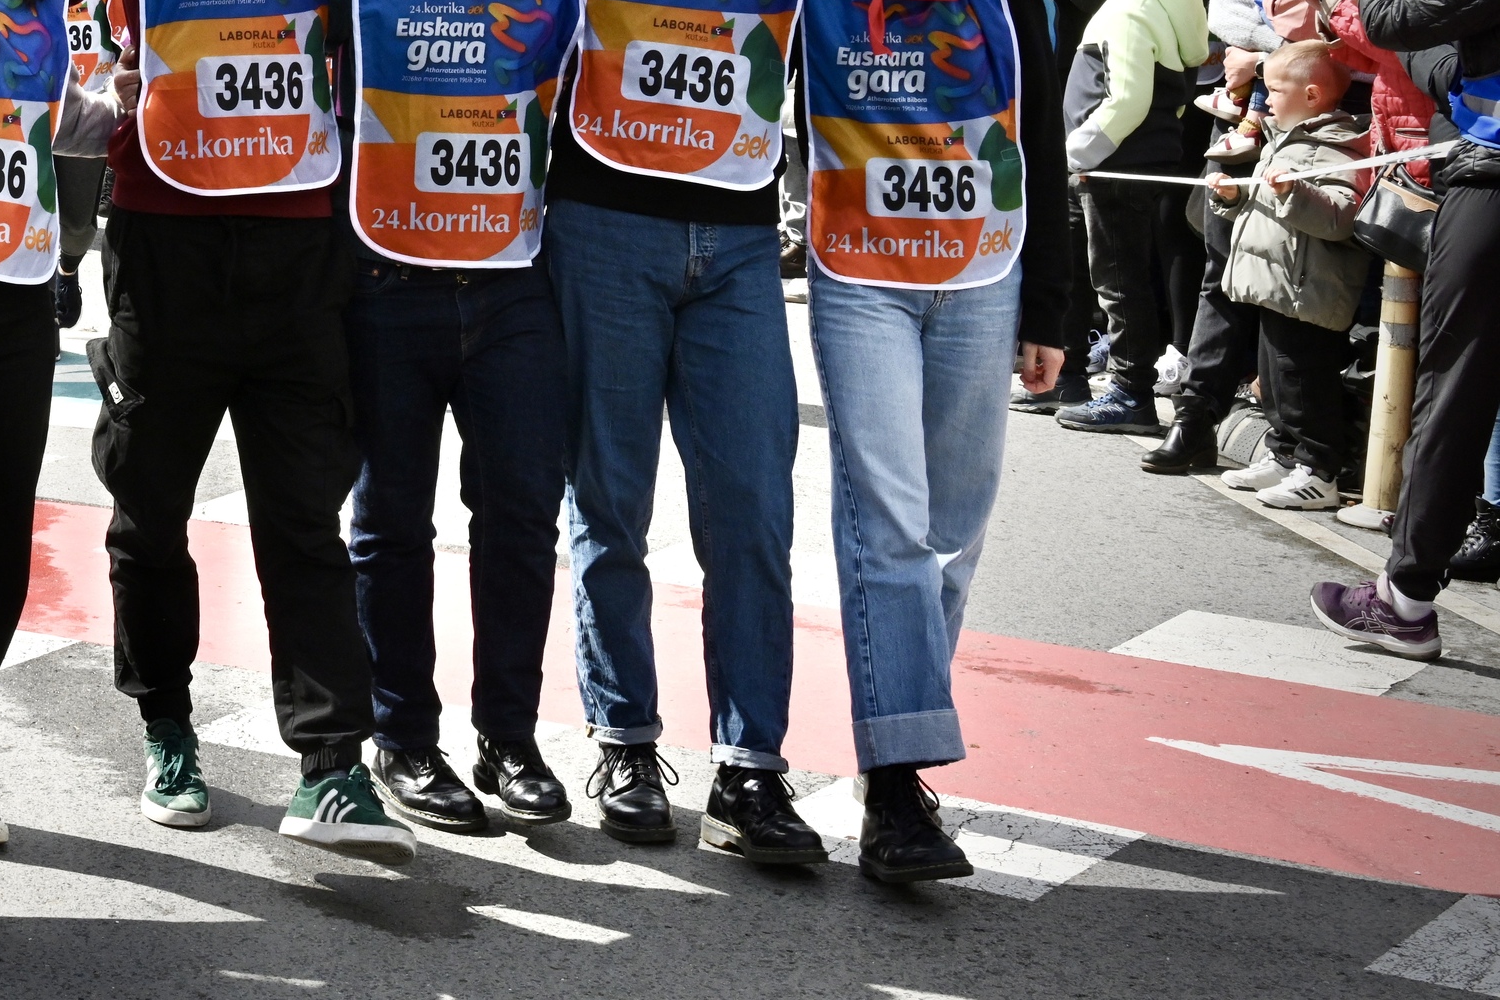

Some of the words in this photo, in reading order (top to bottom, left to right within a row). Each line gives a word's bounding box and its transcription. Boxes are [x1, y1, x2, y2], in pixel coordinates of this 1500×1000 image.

[410, 2, 465, 14] 24.korrika
[219, 30, 276, 42] LABORAL
[396, 16, 485, 38] Euskara
[653, 18, 709, 34] LABORAL
[69, 24, 92, 51] 36
[252, 41, 276, 49] kutxa
[685, 33, 708, 43] kutxa
[850, 32, 902, 45] 24.krika
[407, 39, 486, 71] gara
[425, 66, 465, 74] Atharratzetik
[639, 50, 735, 107] 3436
[216, 62, 304, 112] 3436
[847, 69, 926, 100] gara
[440, 109, 495, 120] LABORAL
[472, 120, 495, 128] kutxa
[158, 126, 295, 161] 24.korrika
[308, 122, 330, 157] aek
[576, 110, 715, 151] 24.korrika
[732, 129, 771, 161] aek
[887, 136, 942, 146] LABORAL
[920, 146, 943, 155] kutxa
[430, 139, 521, 187] 3436
[882, 165, 976, 213] 3436
[372, 202, 510, 234] 24.korrika
[825, 226, 965, 259] 24.korrika
[978, 219, 1013, 257] aek
